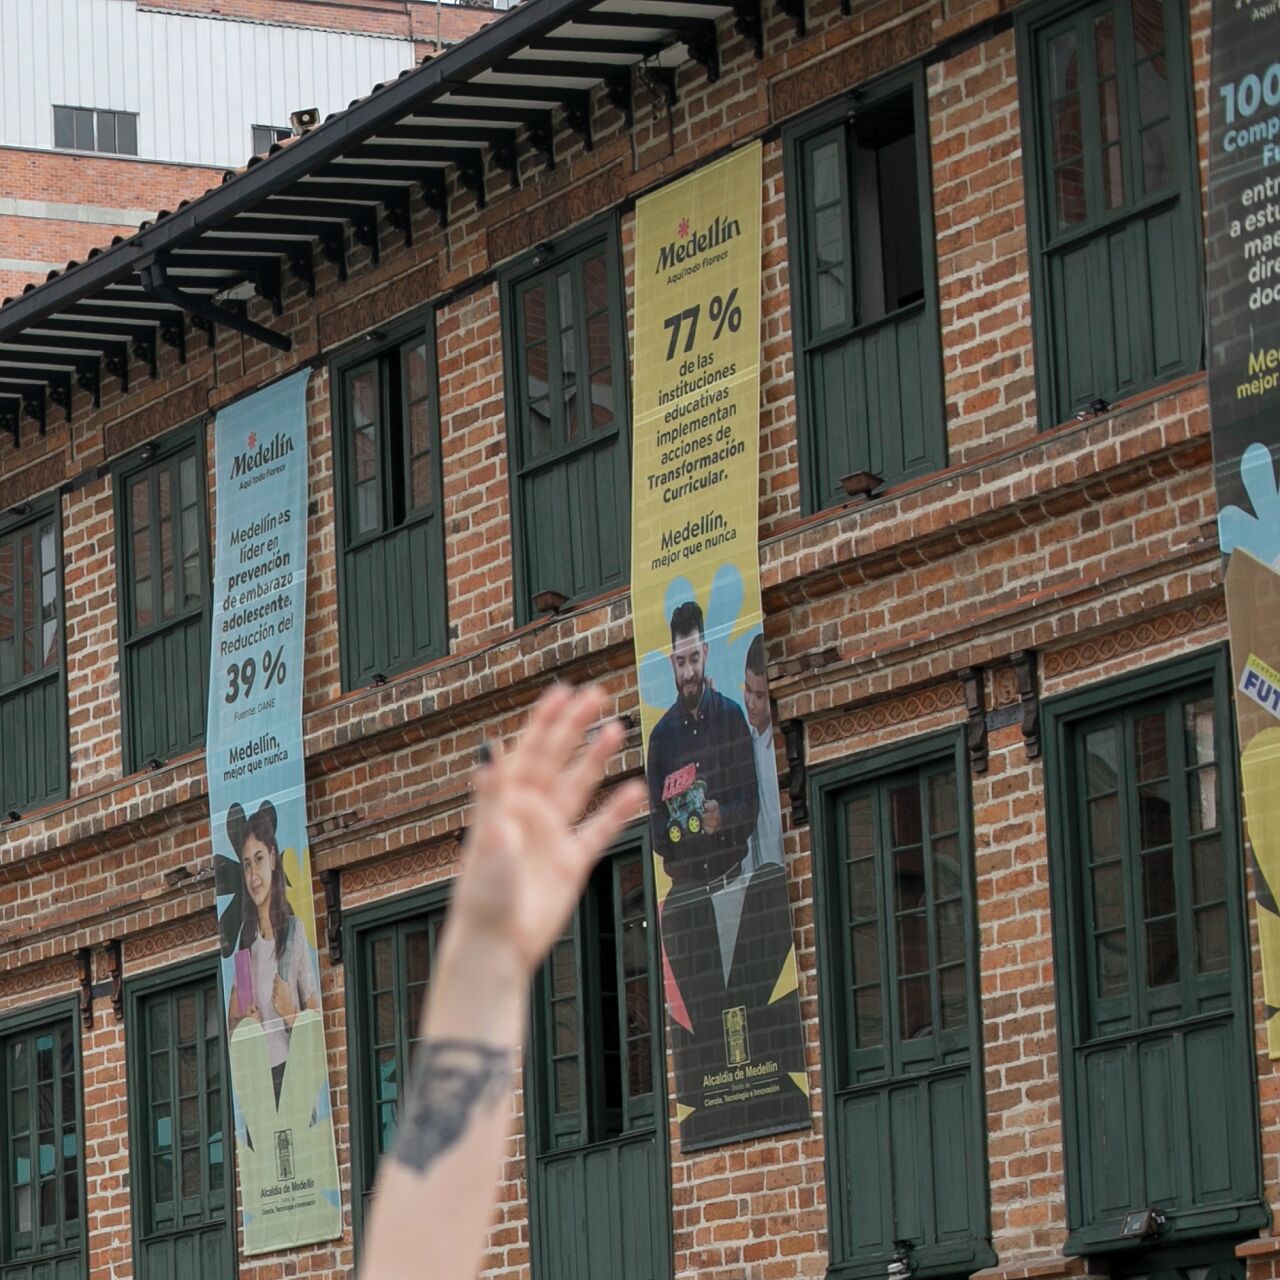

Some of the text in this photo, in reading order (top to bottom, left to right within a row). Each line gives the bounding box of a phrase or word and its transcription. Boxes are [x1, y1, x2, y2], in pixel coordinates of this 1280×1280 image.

[655, 216, 741, 275] Medellín
[1230, 219, 1241, 237] a
[663, 287, 742, 362] 77 %
[679, 351, 714, 377] de las
[1248, 348, 1280, 376] Me
[658, 363, 737, 407] instituciones
[664, 386, 730, 424] educativas
[1236, 372, 1279, 399] mejor
[656, 403, 737, 447] implementan
[661, 425, 732, 465] acciones de
[230, 431, 295, 480] Medellín
[647, 438, 745, 490] Transformación
[662, 468, 729, 503] Curricular.
[230, 508, 291, 547] Medellín es
[660, 509, 728, 551] Medellín,
[239, 535, 279, 564] líder en
[651, 528, 737, 570] mejor que nunca
[228, 550, 291, 592] prevención
[222, 571, 294, 612] de embarazo
[222, 594, 293, 633] adolescente.
[220, 612, 294, 657] Reducción del
[224, 644, 287, 704] 39 %
[223, 749, 289, 782] mejor que nunca
[229, 732, 280, 765] Medellín,
[733, 1069, 744, 1080] de
